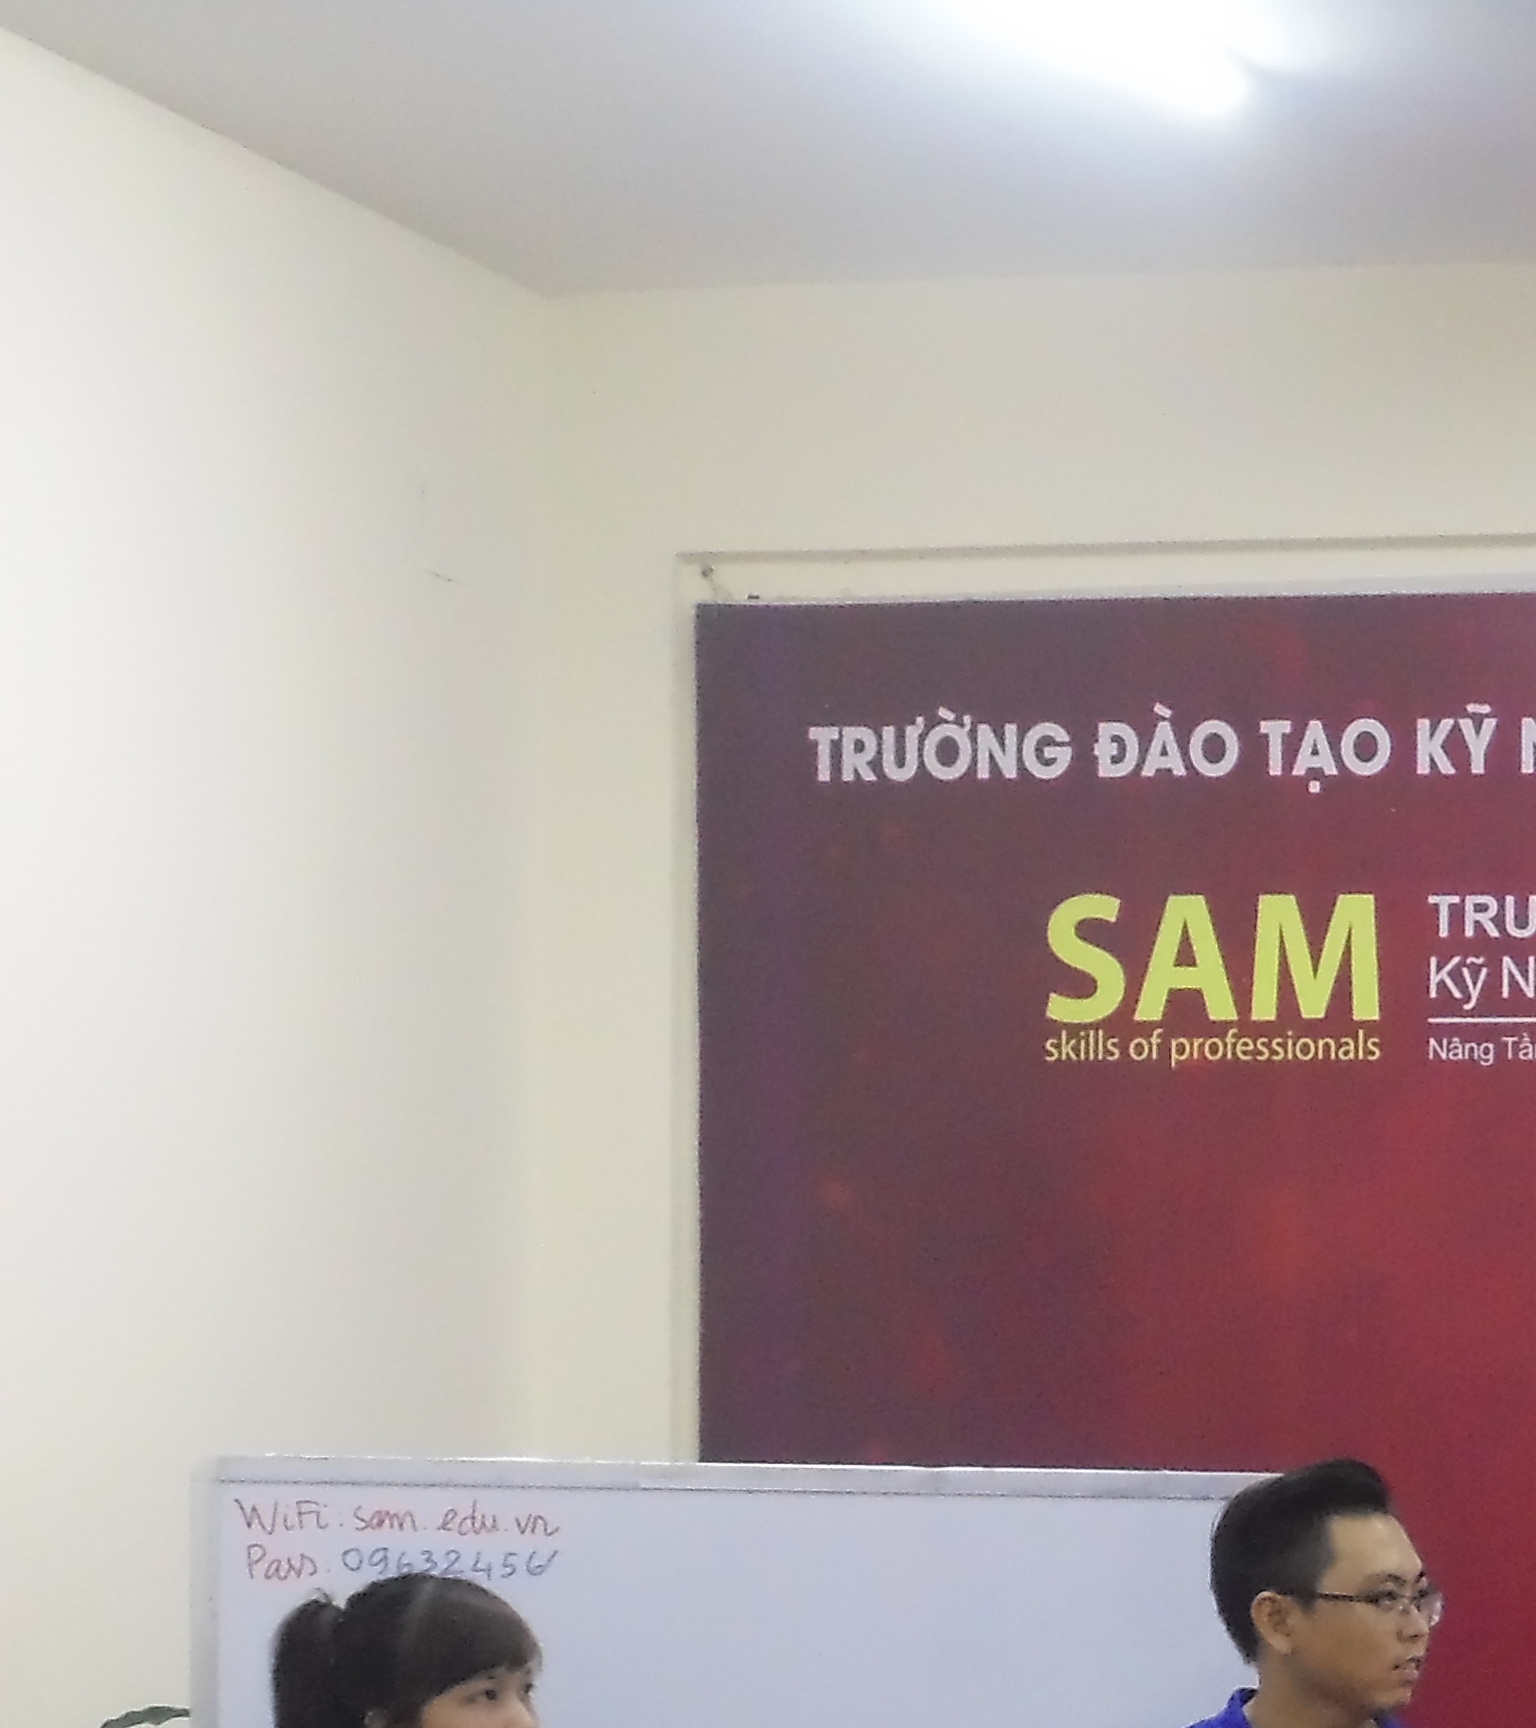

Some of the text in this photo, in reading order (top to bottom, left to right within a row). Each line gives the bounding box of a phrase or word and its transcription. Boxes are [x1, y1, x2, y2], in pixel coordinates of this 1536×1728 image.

[808, 707, 1073, 782] TRƯỜNG
[1094, 702, 1239, 777] ĐÀO
[1259, 717, 1391, 793] TẠO
[1415, 703, 1498, 774] KỸ
[1045, 892, 1381, 1024] SAM
[1428, 954, 1487, 1010] Kỹ
[1044, 1027, 1381, 1068] skills of professionals
[1428, 1037, 1494, 1065] Nâng
